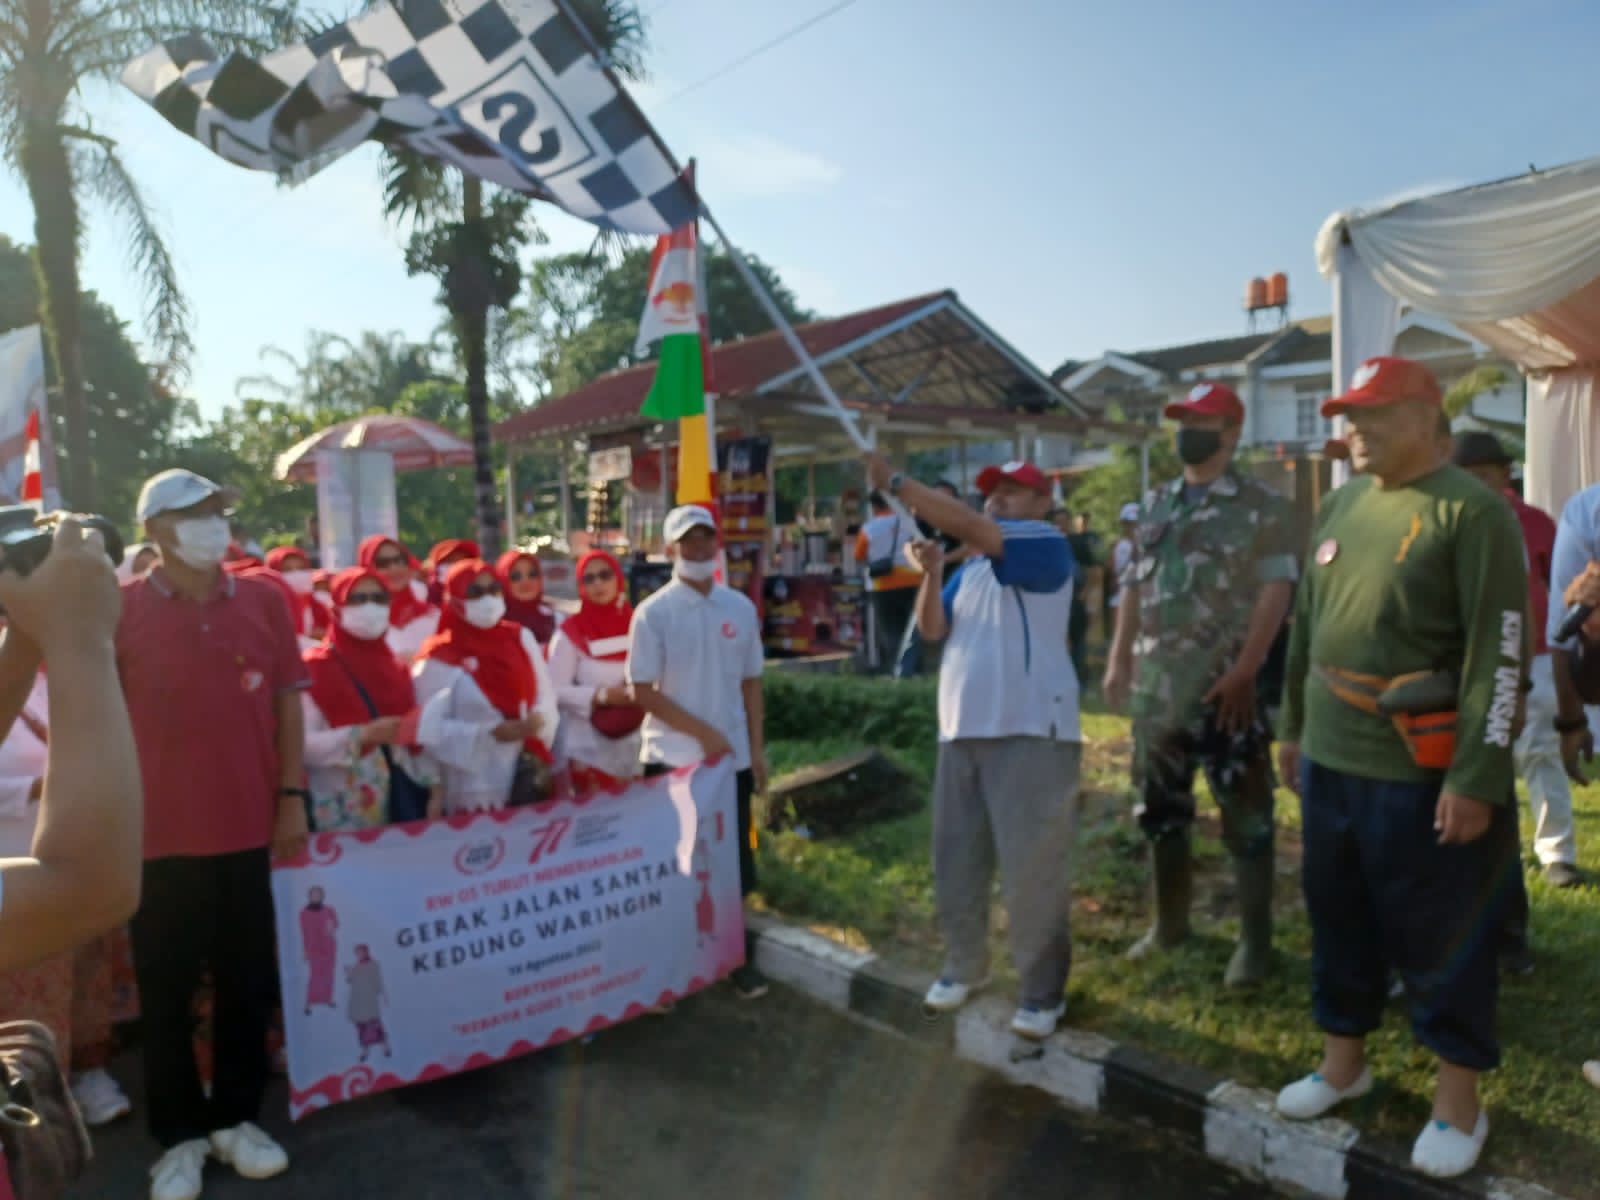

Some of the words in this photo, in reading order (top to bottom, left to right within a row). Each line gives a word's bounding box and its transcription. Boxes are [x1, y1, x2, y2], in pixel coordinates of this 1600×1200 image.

[397, 908, 488, 948] GERAK
[500, 884, 581, 921] JALAN
[412, 927, 526, 974] KEDUNG
[536, 889, 664, 940] WARINGIN
[425, 894, 453, 912] RW
